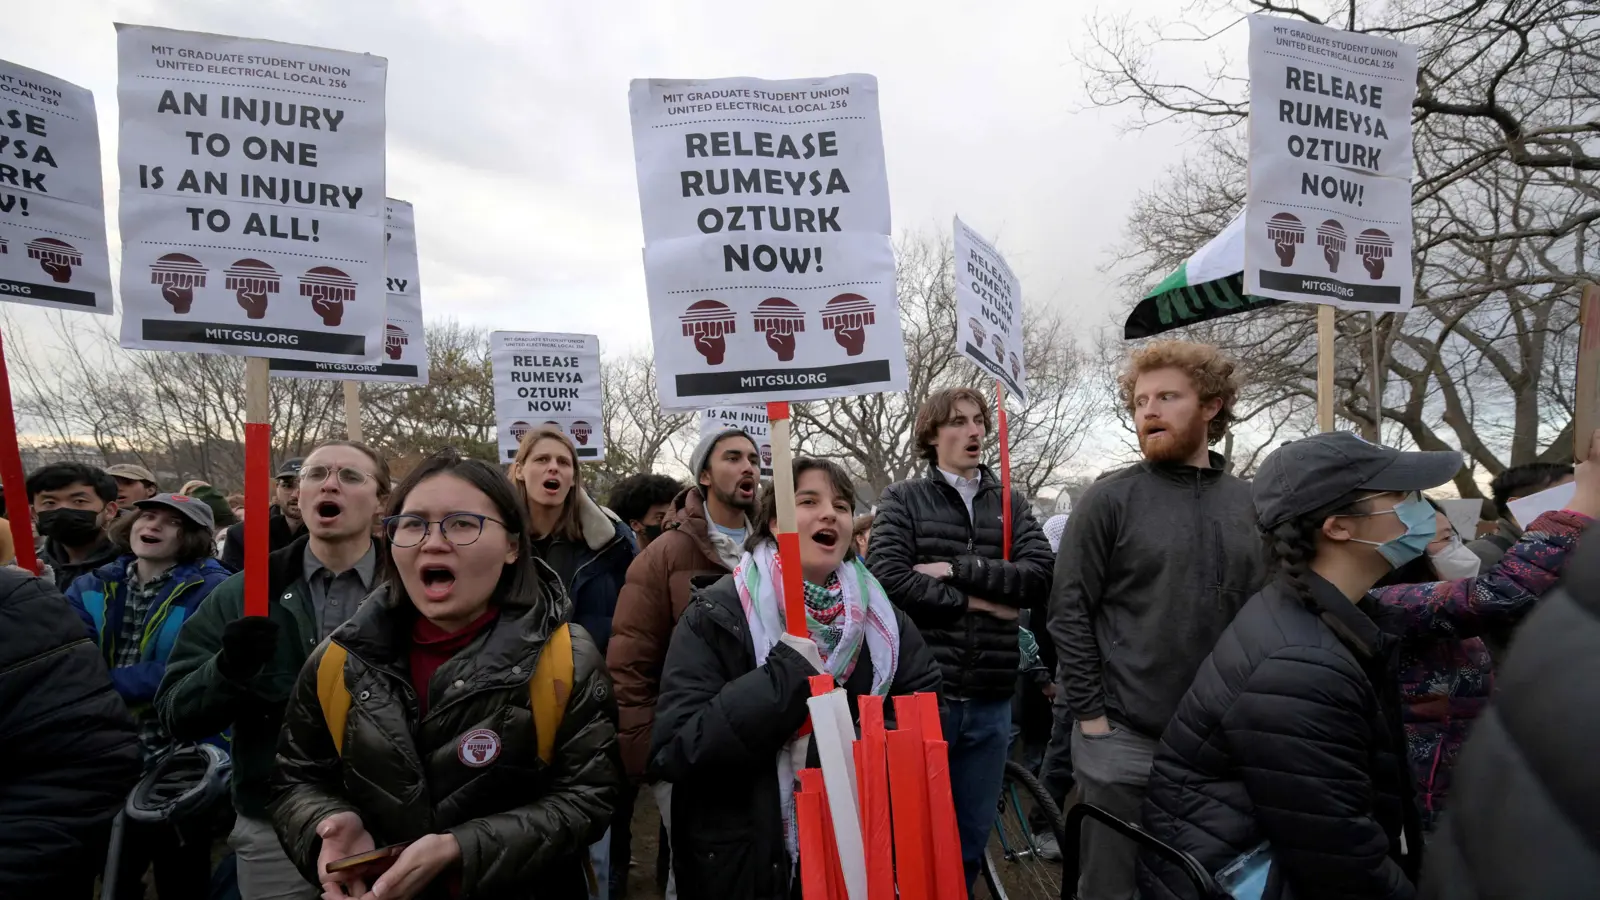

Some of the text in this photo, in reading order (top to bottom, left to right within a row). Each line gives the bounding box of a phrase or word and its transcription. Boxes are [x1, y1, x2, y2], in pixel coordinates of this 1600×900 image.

[1274, 26, 1398, 58] MIT GRADUATE STUDENT UNION
[1276, 37, 1395, 69] UNITED ELECTRICAL LOCAL 256
[151, 45, 351, 76] MIT GRADUATE STUDENT UNION
[156, 59, 347, 89] UNITED ELECTRICAL LOCAL 256
[18, 80, 62, 98] UNION
[40, 96, 59, 106] 256
[662, 86, 850, 104] MIT GRADUATE STUDENT UNION
[1286, 66, 1382, 110] RELEASE
[157, 90, 344, 132] AN INJURY
[668, 99, 848, 116] UNITED ELECTRICAL LOCAL 256
[1280, 99, 1388, 140] RUMEYSA
[185, 131, 318, 168] TO ONE
[685, 131, 838, 160] RELEASE
[1288, 134, 1382, 171] OZTURK
[140, 164, 362, 210] IS AN INJURY
[680, 168, 850, 198] RUMEYSA
[1301, 172, 1364, 208] NOW!
[186, 207, 320, 242] TO ALL!
[697, 206, 842, 234] OZTURK
[723, 244, 824, 274] NOW!
[970, 248, 1012, 297] RELEASE
[968, 261, 1014, 314] RUMEYSA
[1302, 280, 1354, 297] MITGSU.ORG
[972, 281, 1012, 326] OZTURK
[982, 304, 1010, 338] NOW!
[205, 328, 299, 345] MITGSU.ORG
[316, 362, 377, 372] MITGSU.ORG
[513, 356, 579, 367] RELEASE
[511, 371, 583, 383] RUMEYSA
[740, 372, 827, 388] MITGSU.ORG
[518, 387, 580, 398] OZTURK
[528, 401, 572, 412] NOW!
[708, 410, 716, 418] IS
[720, 410, 737, 420] AN
[742, 425, 766, 436] ALL!
